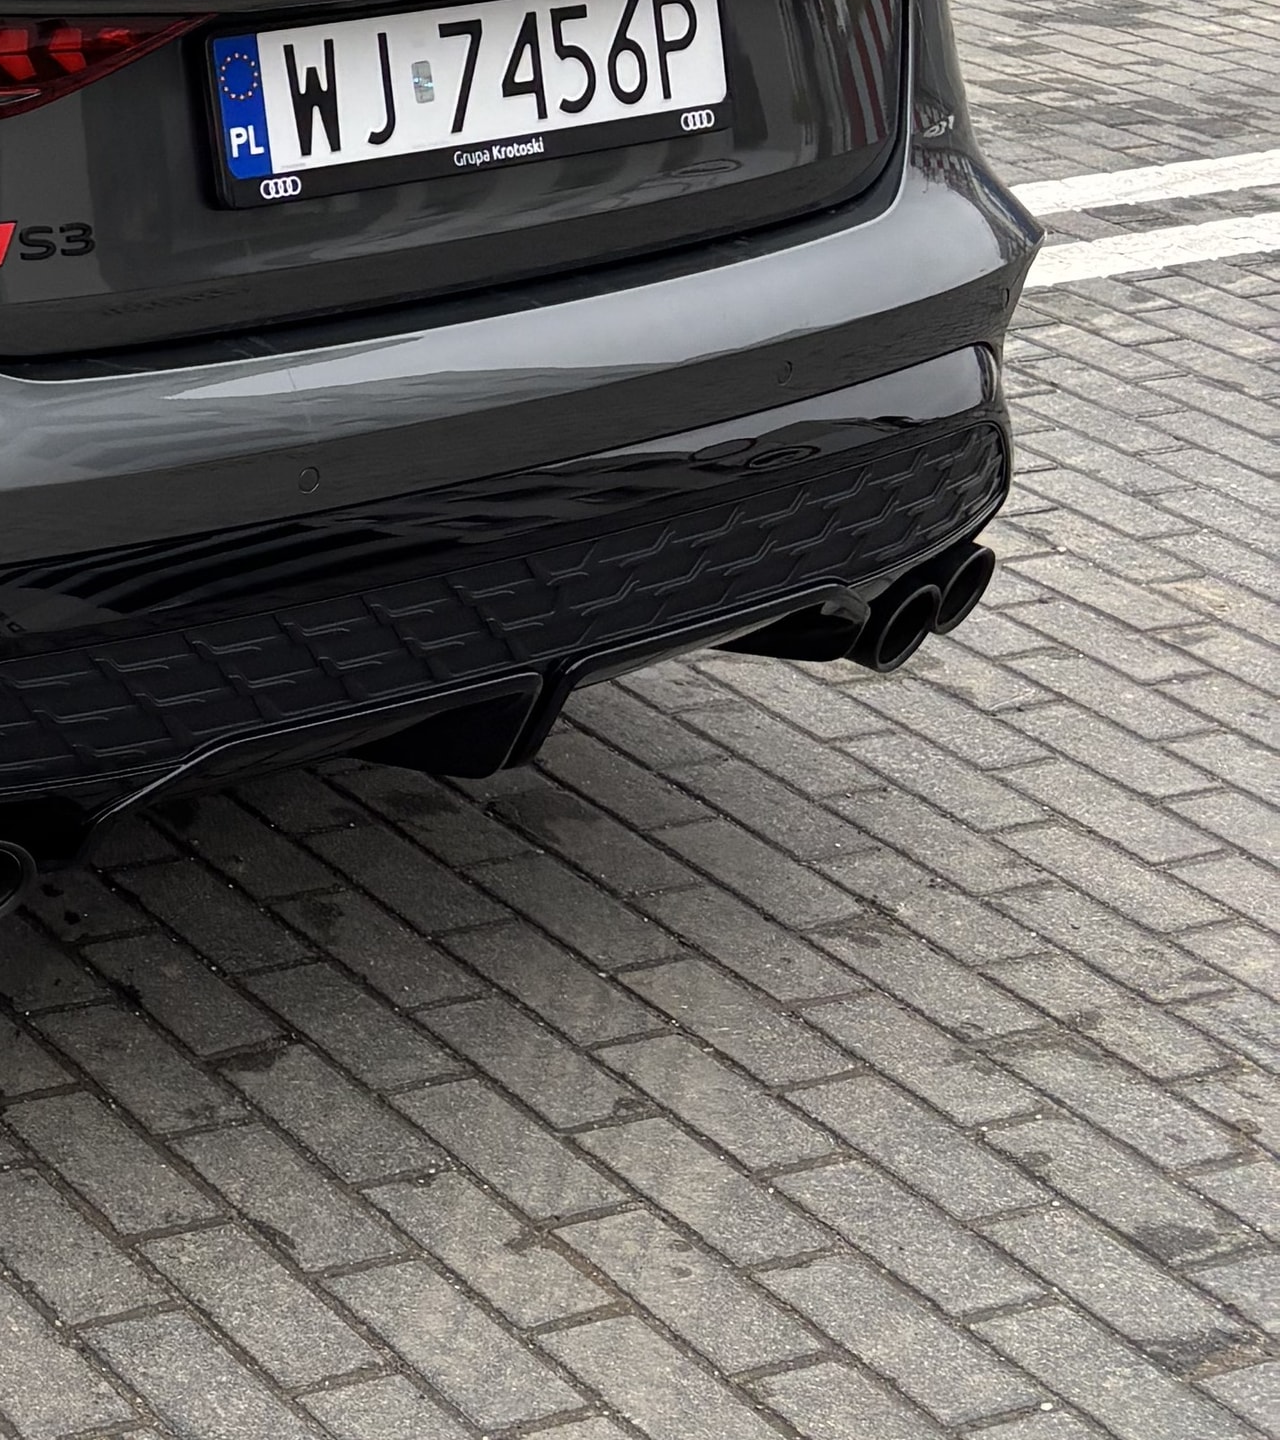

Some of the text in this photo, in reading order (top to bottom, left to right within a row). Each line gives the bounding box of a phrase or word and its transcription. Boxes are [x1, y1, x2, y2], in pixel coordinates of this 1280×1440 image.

[283, 32, 396, 157] WJ
[229, 124, 265, 159] PL
[453, 136, 545, 167] Grupa Krotoski
[18, 222, 96, 261] S3
